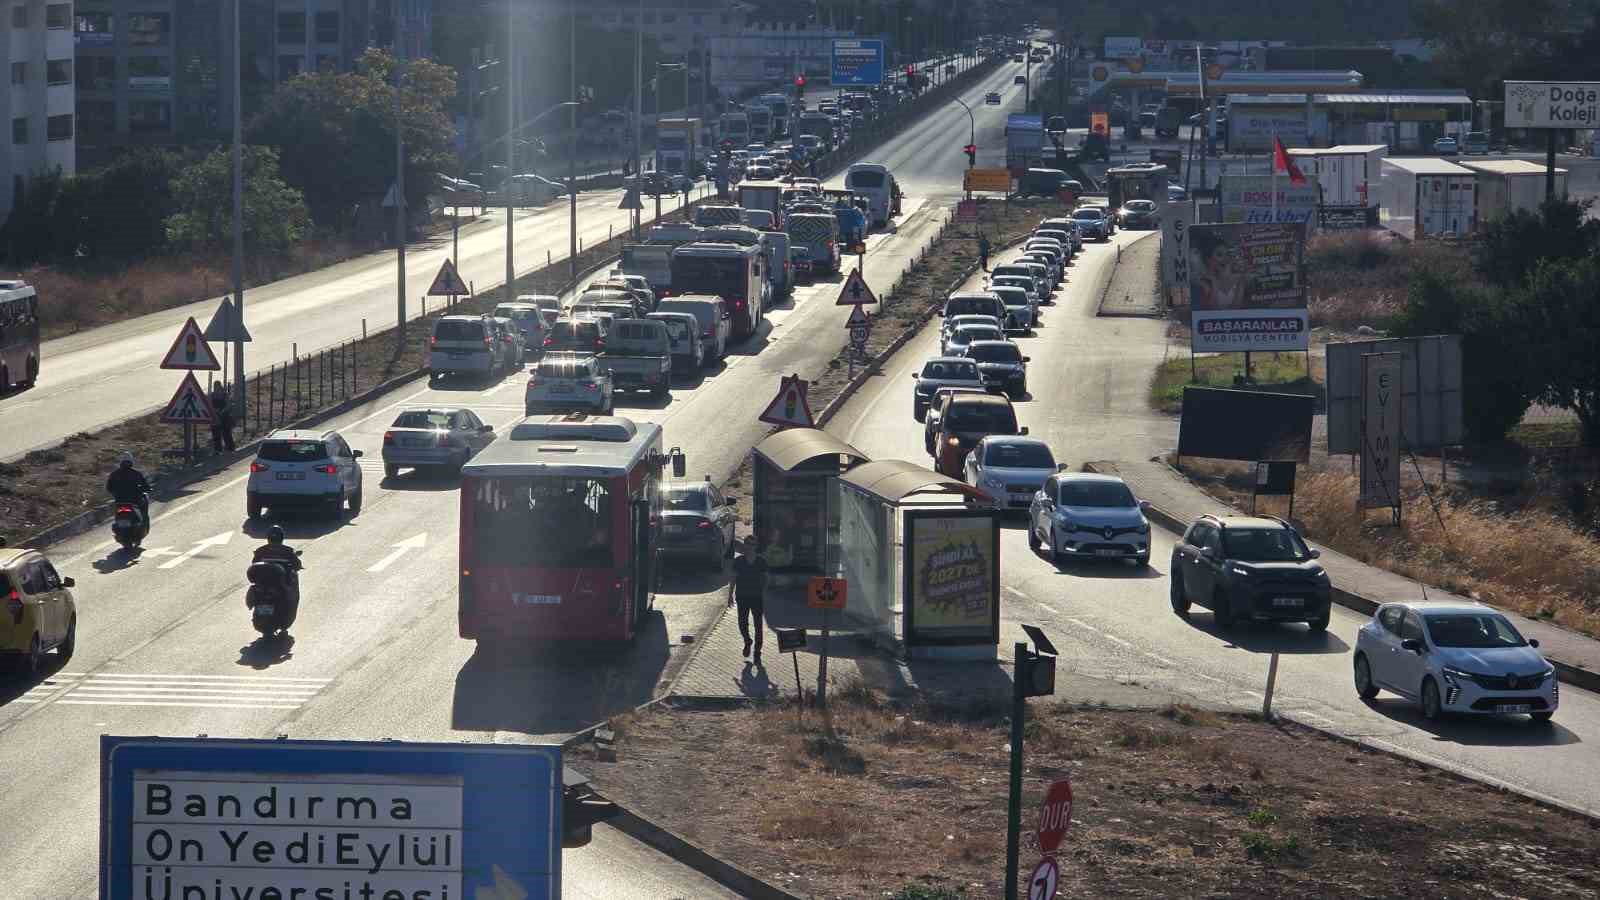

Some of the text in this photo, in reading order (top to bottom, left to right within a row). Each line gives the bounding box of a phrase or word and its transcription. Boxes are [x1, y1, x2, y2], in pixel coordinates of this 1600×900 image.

[1551, 87, 1596, 105] Doğa
[1551, 105, 1596, 124] Koleji
[146, 784, 412, 820] Bandırma
[1040, 801, 1070, 832] DUR
[146, 829, 204, 862] On
